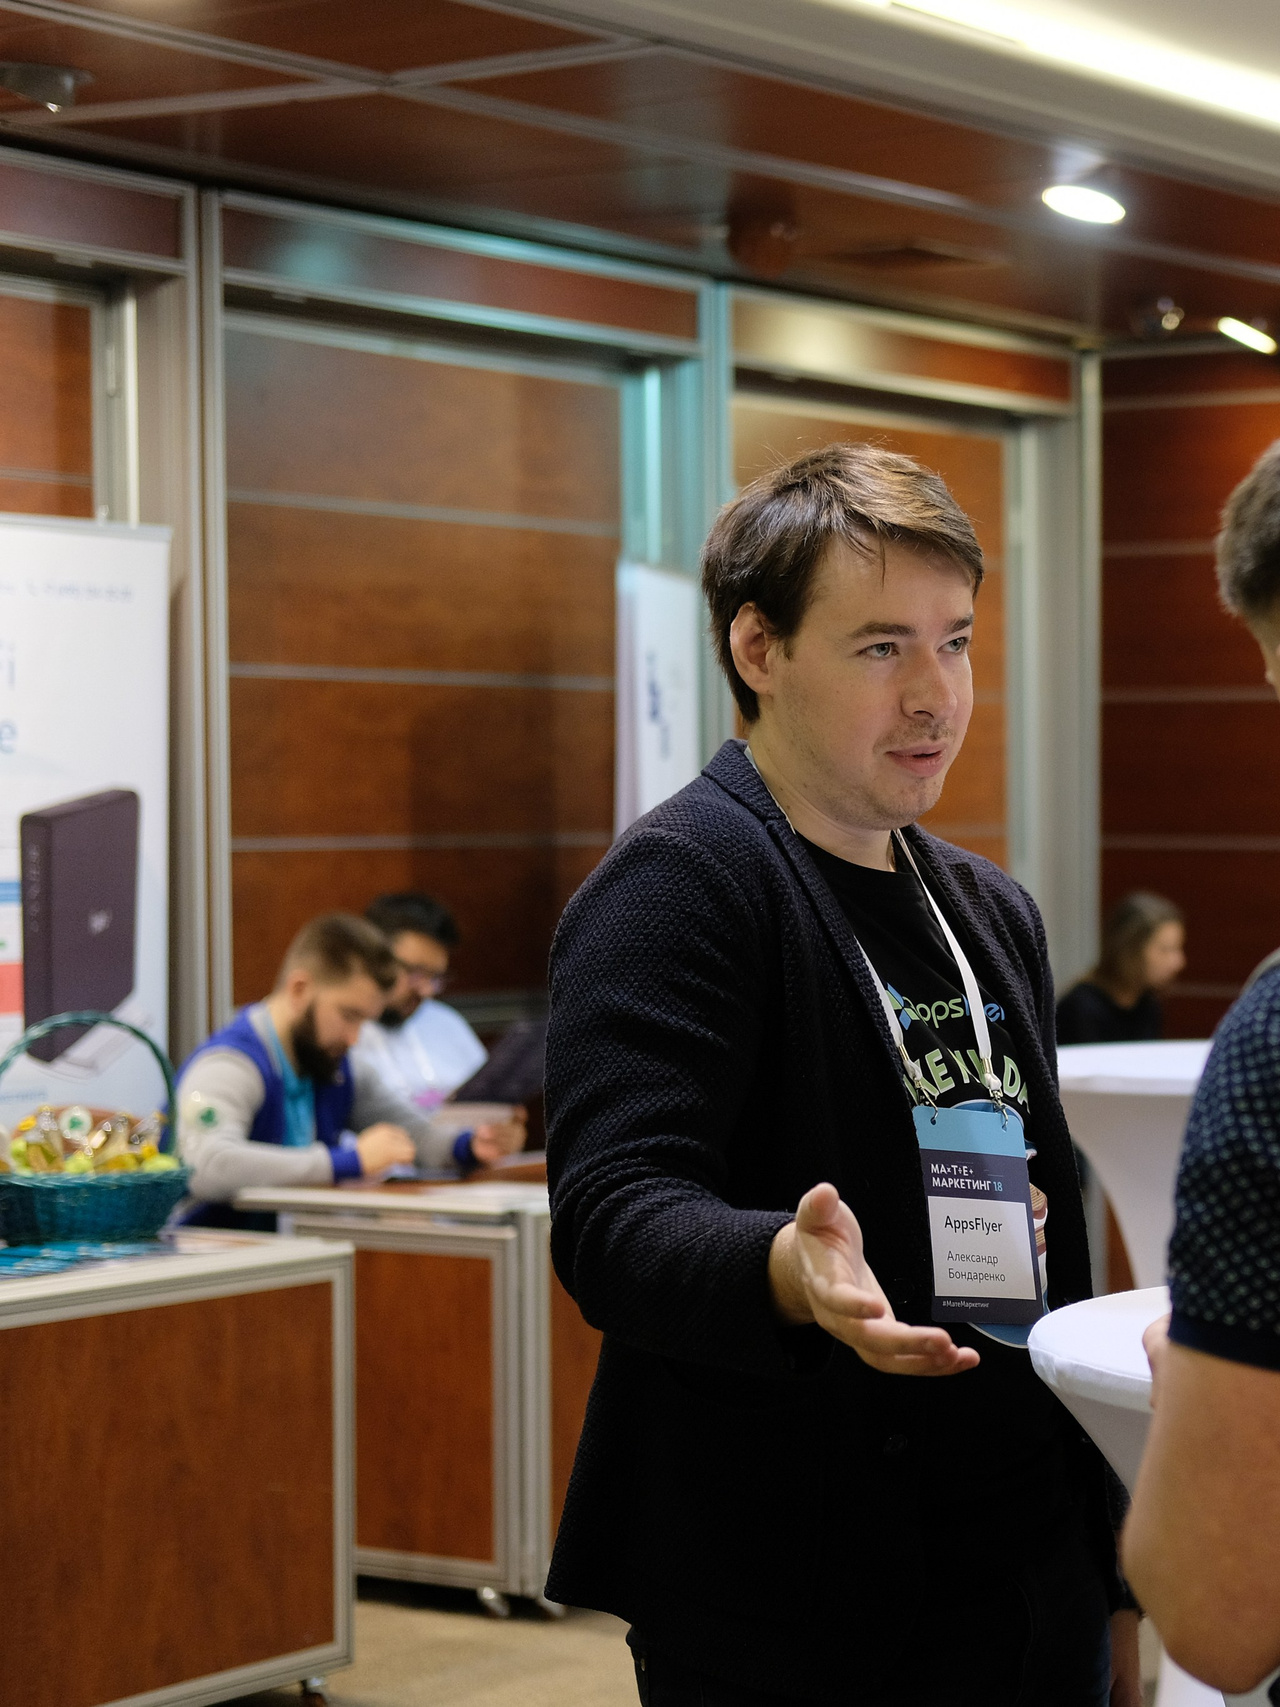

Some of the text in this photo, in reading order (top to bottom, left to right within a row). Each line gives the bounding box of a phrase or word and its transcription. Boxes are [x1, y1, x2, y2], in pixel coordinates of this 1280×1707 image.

[932, 1176, 1003, 1192] МАРКЕТИНГ 18
[944, 1215, 1003, 1235] AppsFlyer
[946, 1250, 999, 1267] Александр
[948, 1268, 1006, 1283] Бондаренко
